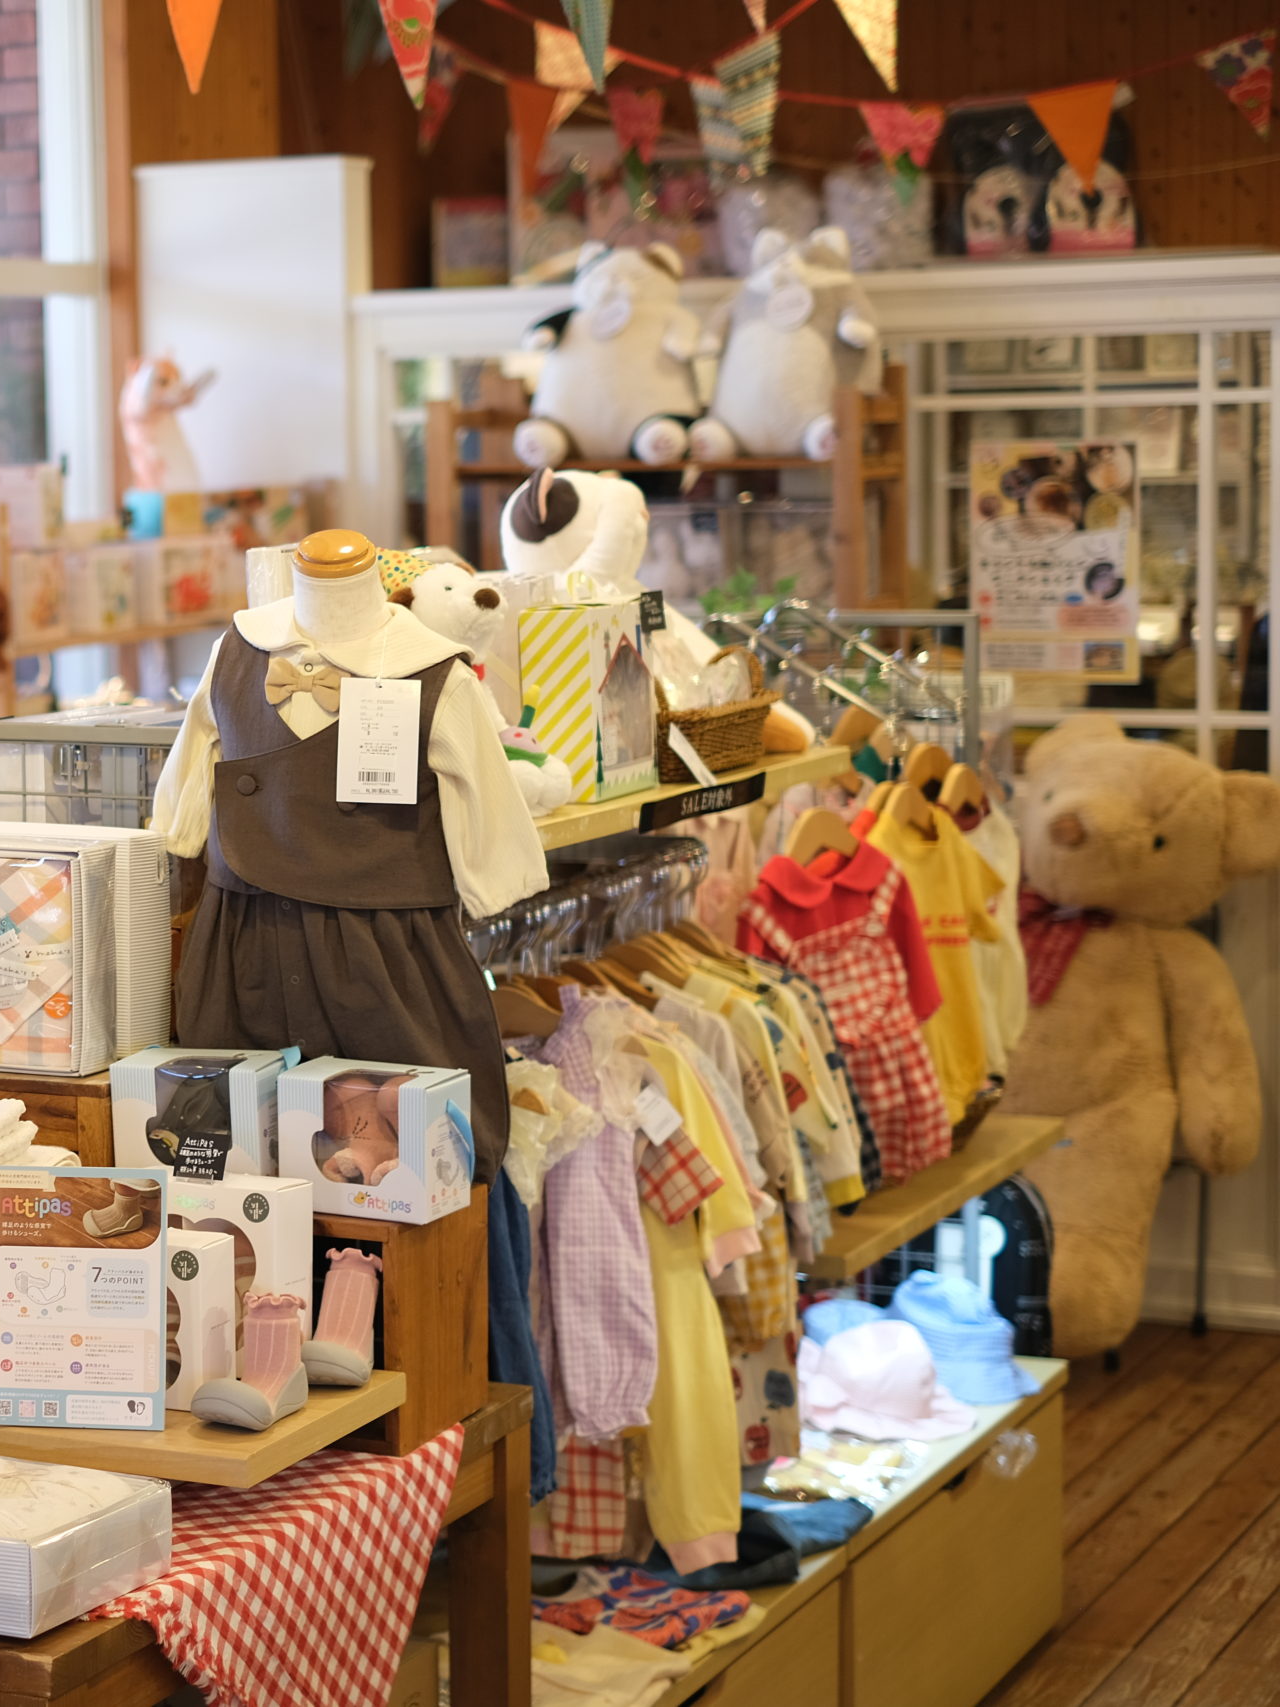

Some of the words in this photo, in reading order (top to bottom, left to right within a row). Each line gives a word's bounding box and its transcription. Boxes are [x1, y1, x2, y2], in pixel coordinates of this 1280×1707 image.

[1, 1194, 73, 1219] Attipas
[367, 1196, 412, 1214] Attipas
[1, 1221, 52, 1229] 裸足のような感覚で
[1, 1229, 42, 1237] 歩けるシューズ。
